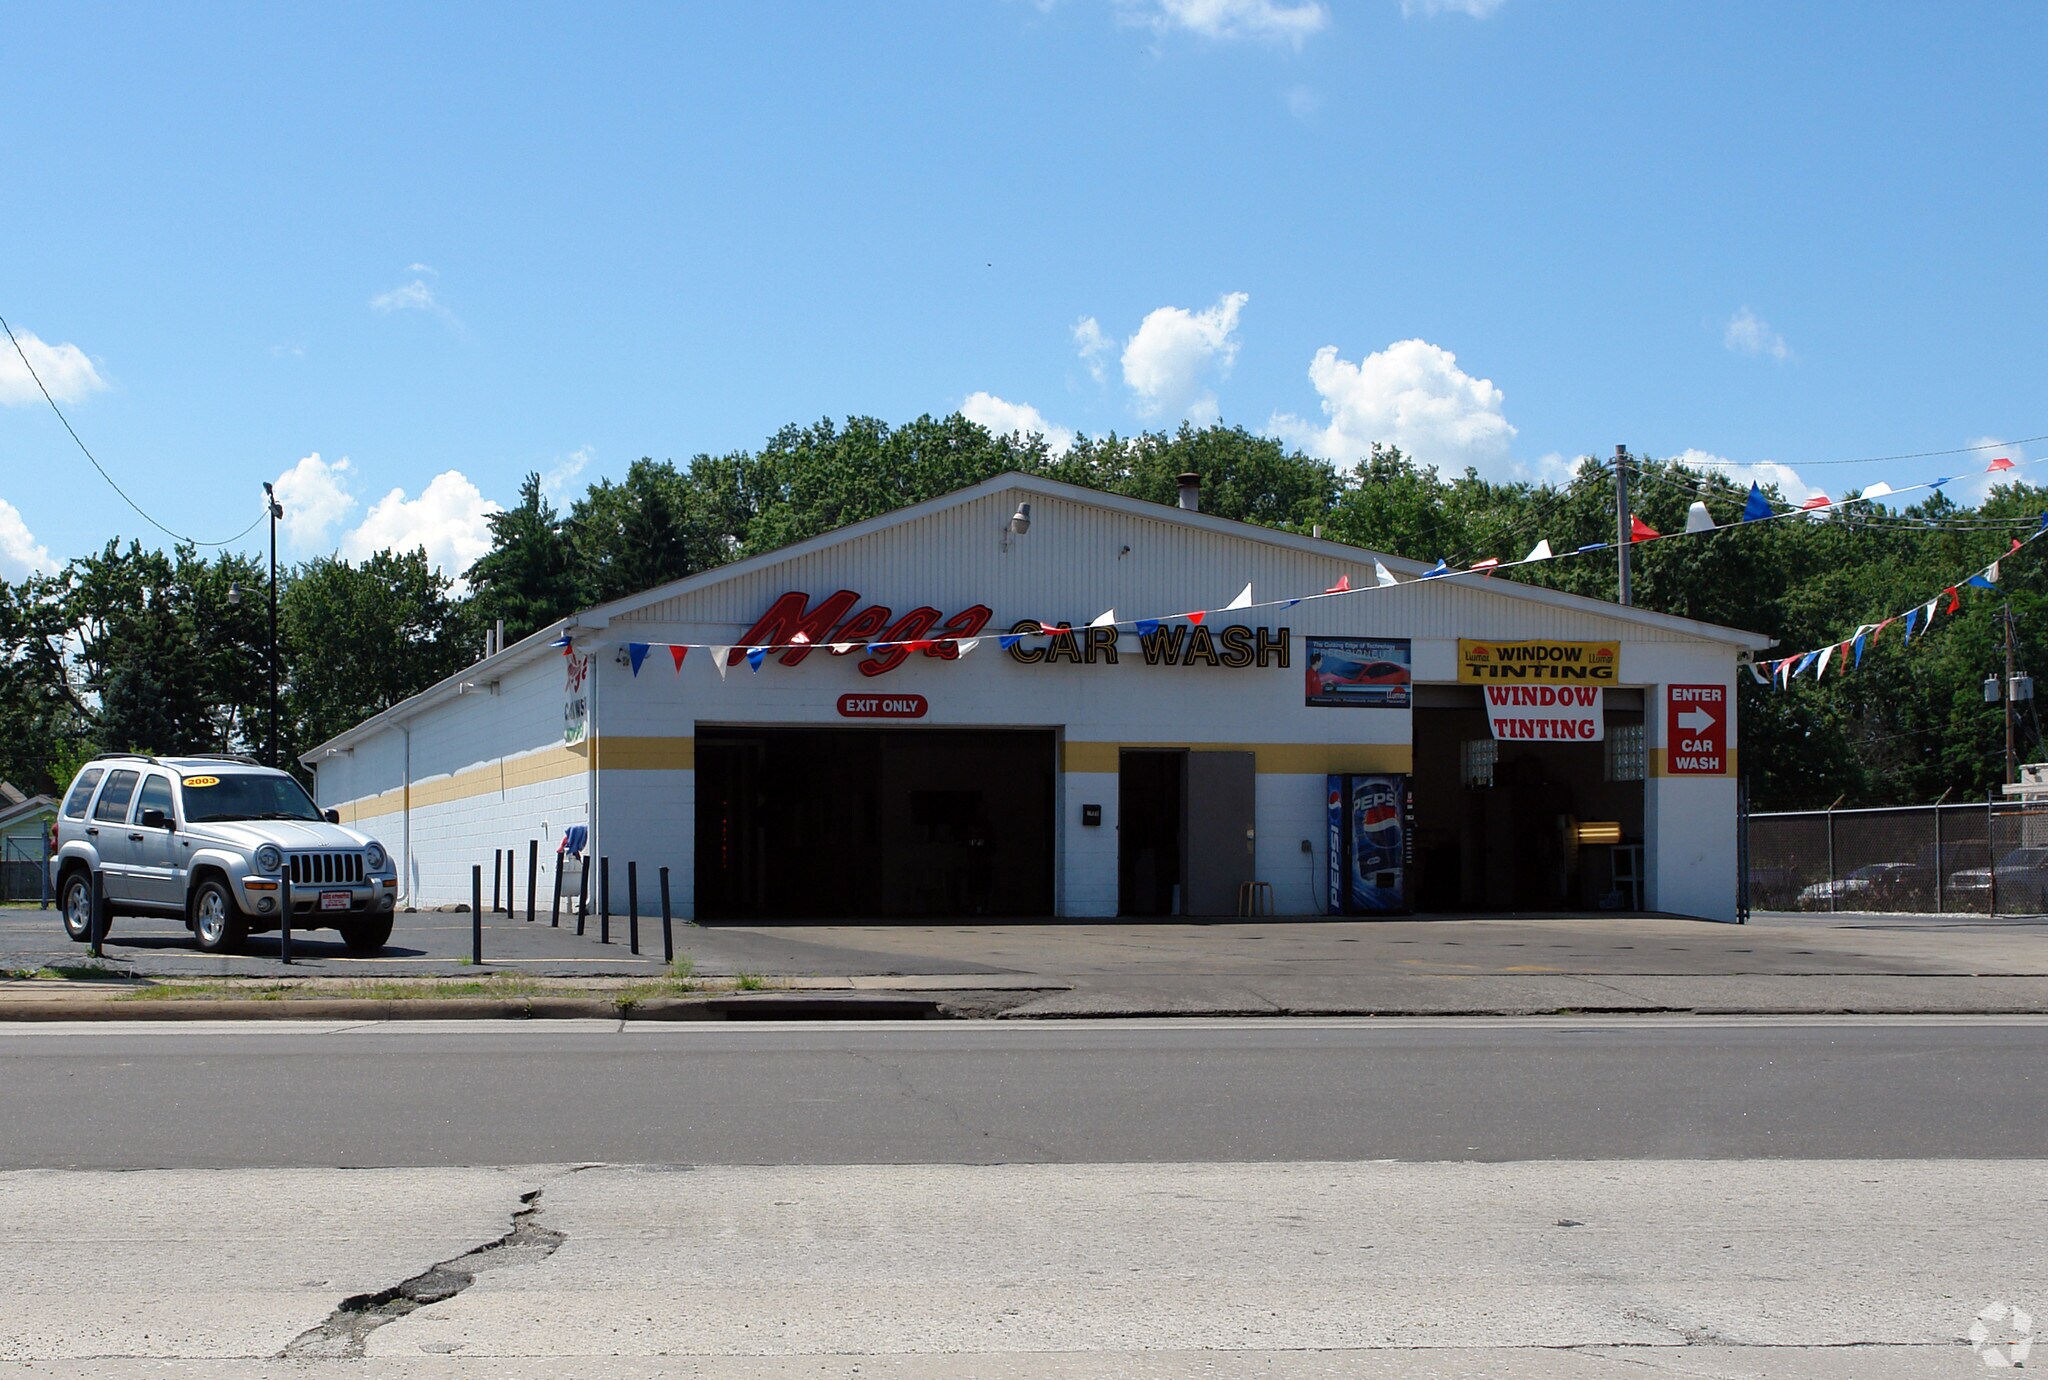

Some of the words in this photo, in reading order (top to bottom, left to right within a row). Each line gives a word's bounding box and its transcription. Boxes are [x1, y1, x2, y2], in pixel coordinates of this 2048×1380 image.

[727, 590, 993, 676] Mega
[1008, 619, 1118, 664] CAR
[1138, 624, 1290, 668] WASH
[1496, 646, 1583, 662] WINDOW
[1465, 664, 1613, 678] TINTING
[1487, 686, 1598, 706] WINDOW
[1672, 688, 1722, 702] ENTER
[846, 699, 878, 712] EXIT
[882, 700, 918, 712] ONLY
[1494, 718, 1595, 739] TINTING
[1681, 739, 1713, 752] CAR
[1676, 757, 1719, 770] WASH
[1331, 825, 1340, 908] PEPSI
